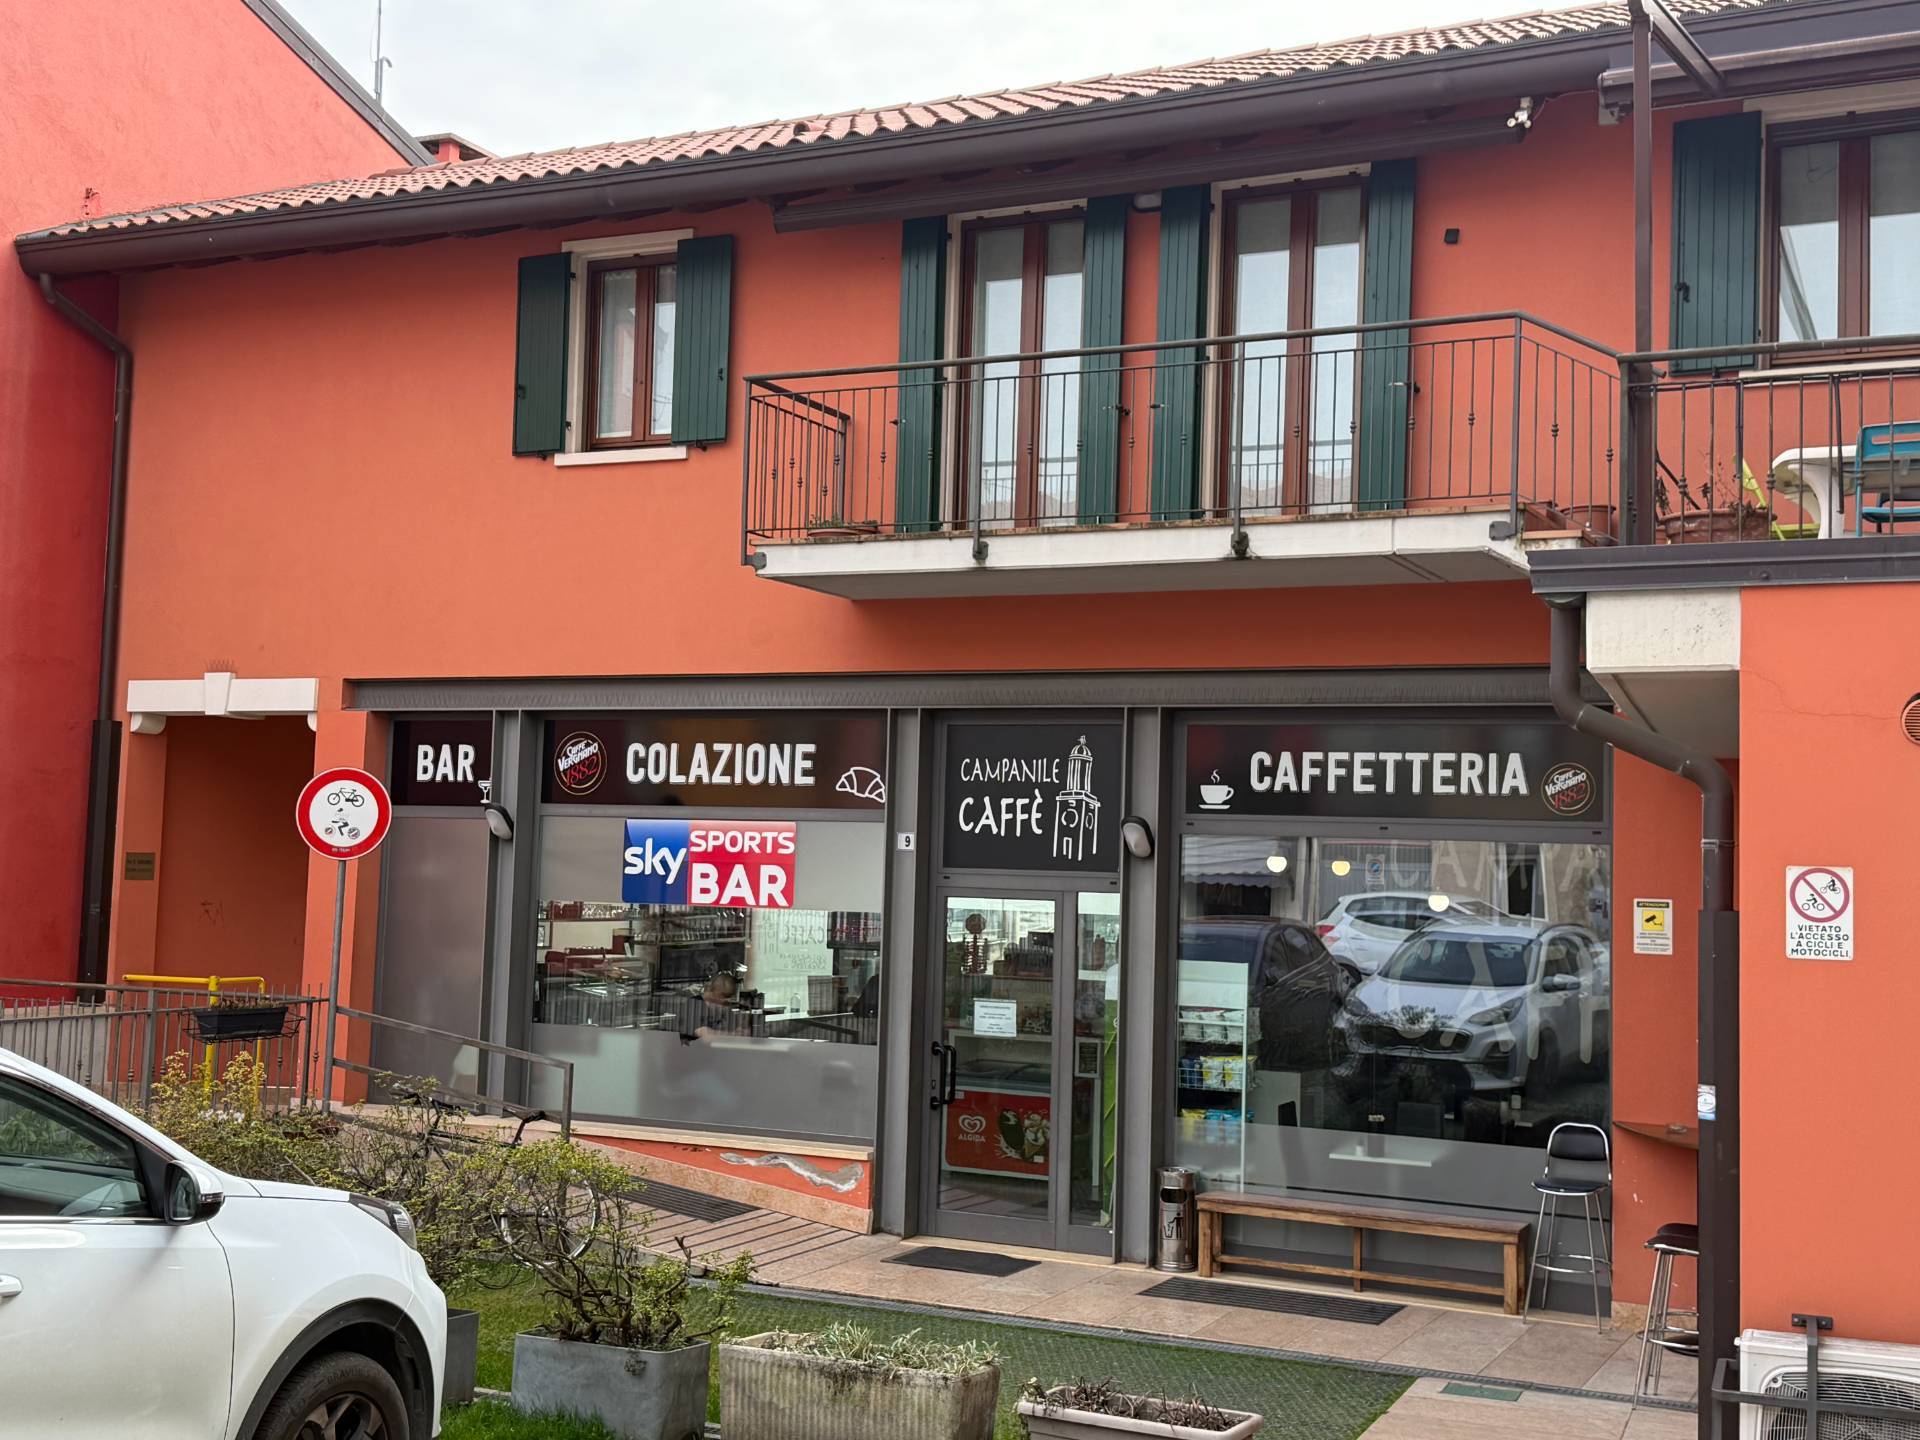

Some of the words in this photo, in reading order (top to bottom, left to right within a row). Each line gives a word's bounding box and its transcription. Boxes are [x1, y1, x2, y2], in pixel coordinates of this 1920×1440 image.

[416, 744, 476, 784] BAR
[566, 755, 598, 787] 1882
[626, 742, 817, 786] COLAZIONE
[960, 757, 1061, 784] CAMPANILE
[1249, 751, 1529, 796] CAFFETTERIA
[1554, 783, 1586, 810] 1882
[958, 788, 1044, 838] CAFFÈ
[689, 830, 795, 855] SPORTS
[904, 835, 912, 848] 9
[624, 838, 687, 885] sky
[690, 862, 789, 907] BAR
[1790, 932, 1850, 941] L'ACCESSO
[1797, 924, 1842, 933] VIETATO
[1791, 948, 1849, 957] MOTOCICLI
[1806, 940, 1834, 949] CICLI
[1837, 941, 1844, 949] E
[957, 1133, 986, 1143] ALGIDA
